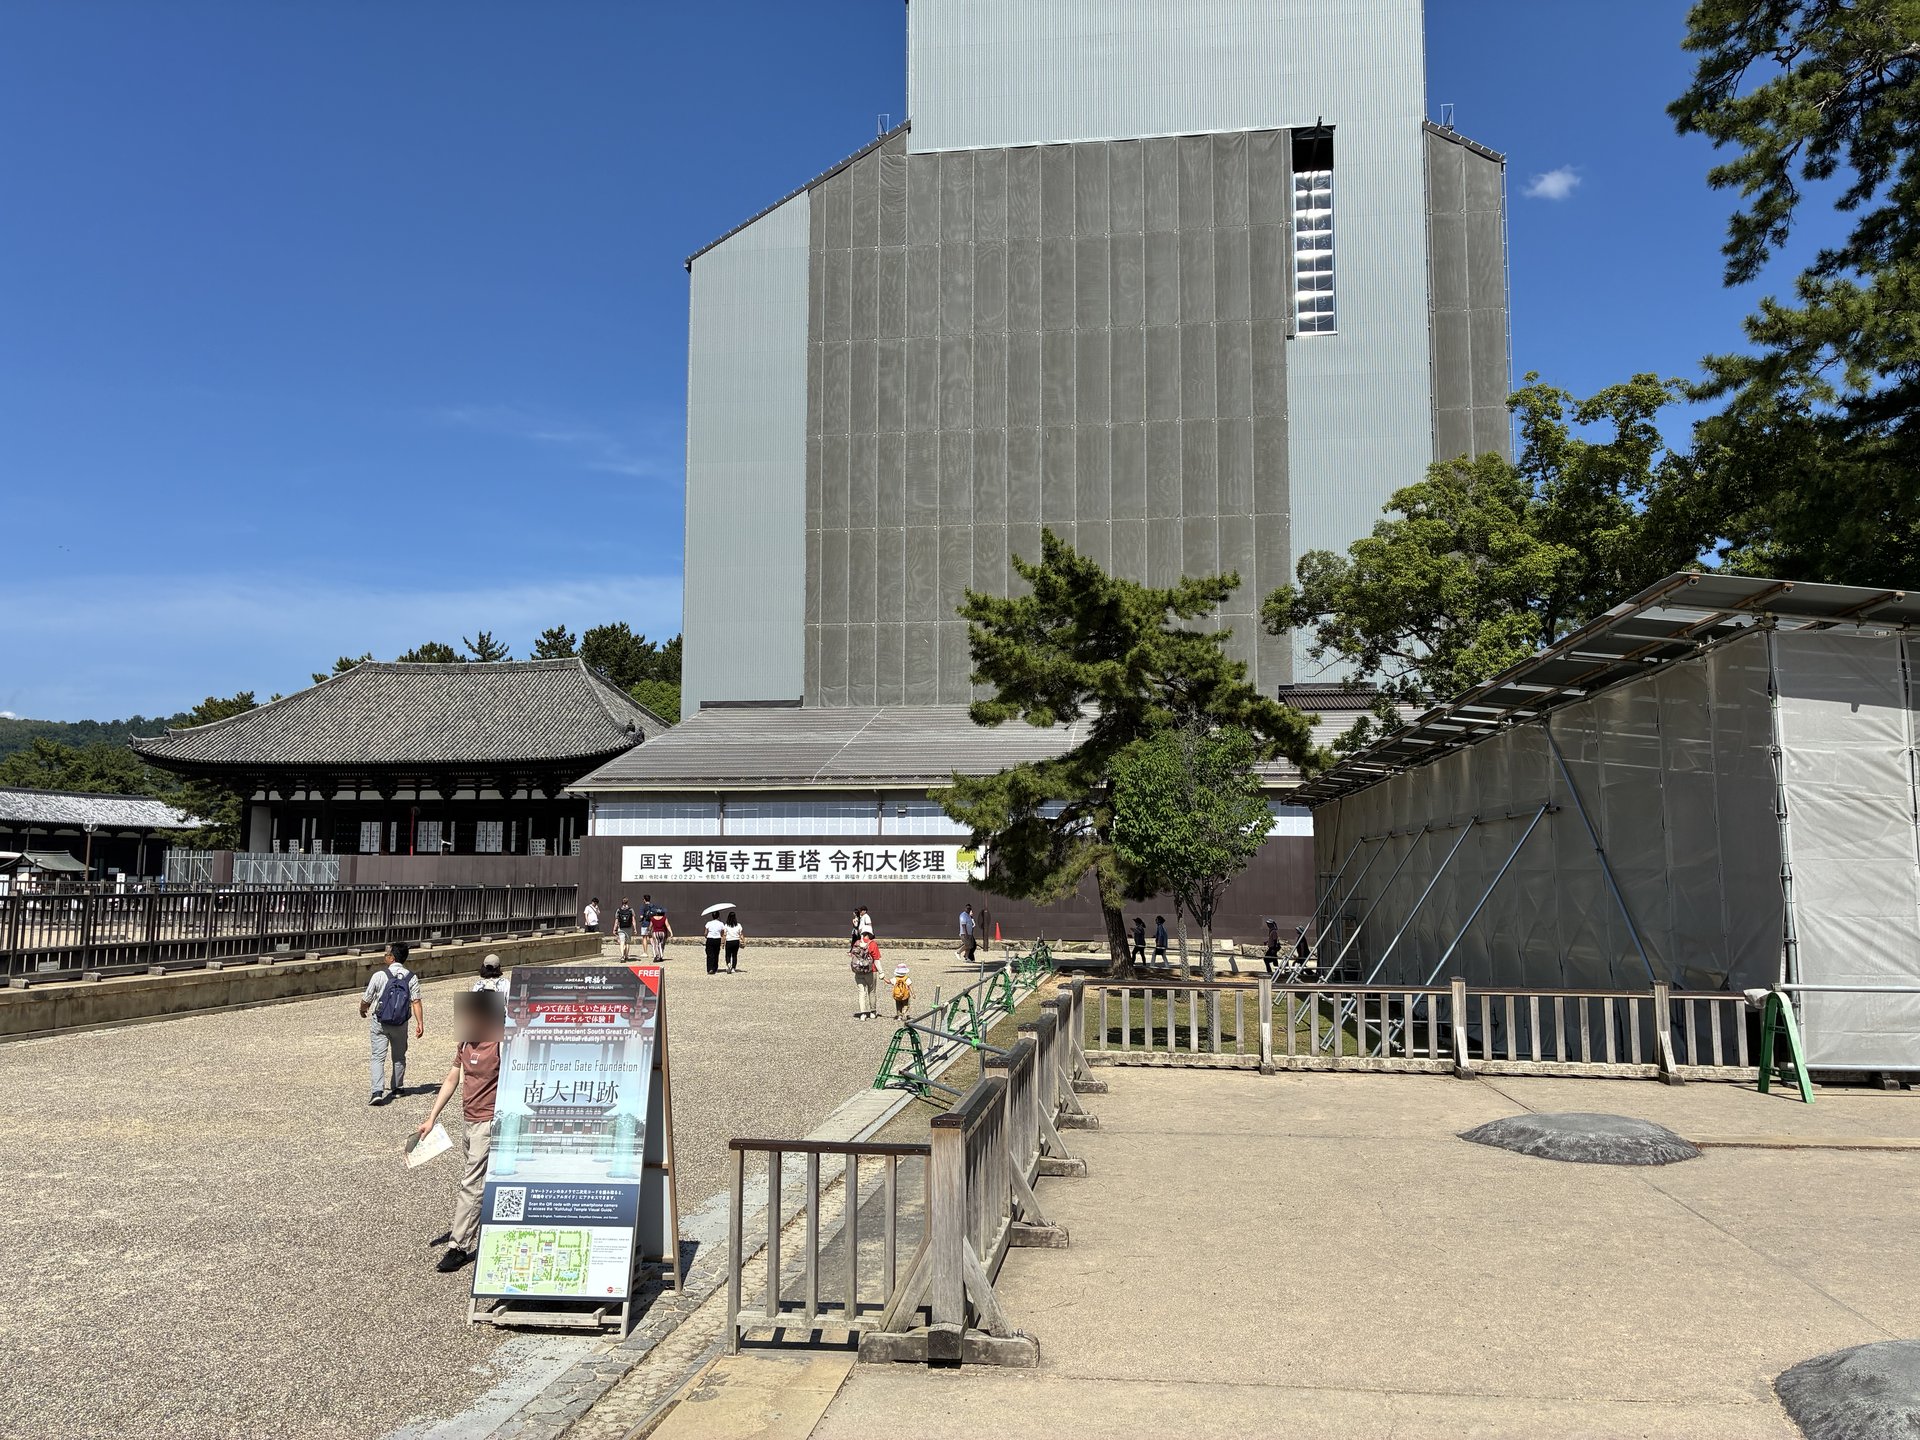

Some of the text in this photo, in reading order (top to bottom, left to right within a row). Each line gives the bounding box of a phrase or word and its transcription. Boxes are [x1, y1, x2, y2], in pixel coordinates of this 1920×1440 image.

[640, 854, 673, 870] 国宝
[683, 850, 821, 873] 興福寺五重塔
[828, 849, 945, 872] 令和大修理
[638, 969, 660, 978] FREE
[535, 1004, 629, 1013] かつて存在していた南大門を
[548, 1015, 611, 1023] バーチャルで体験！
[520, 1028, 552, 1036] Experience
[586, 1028, 605, 1036] South
[623, 1029, 638, 1037] Gate
[511, 1059, 638, 1072] Southern Great Gate Foundation
[523, 1079, 620, 1104] 南大門跡
